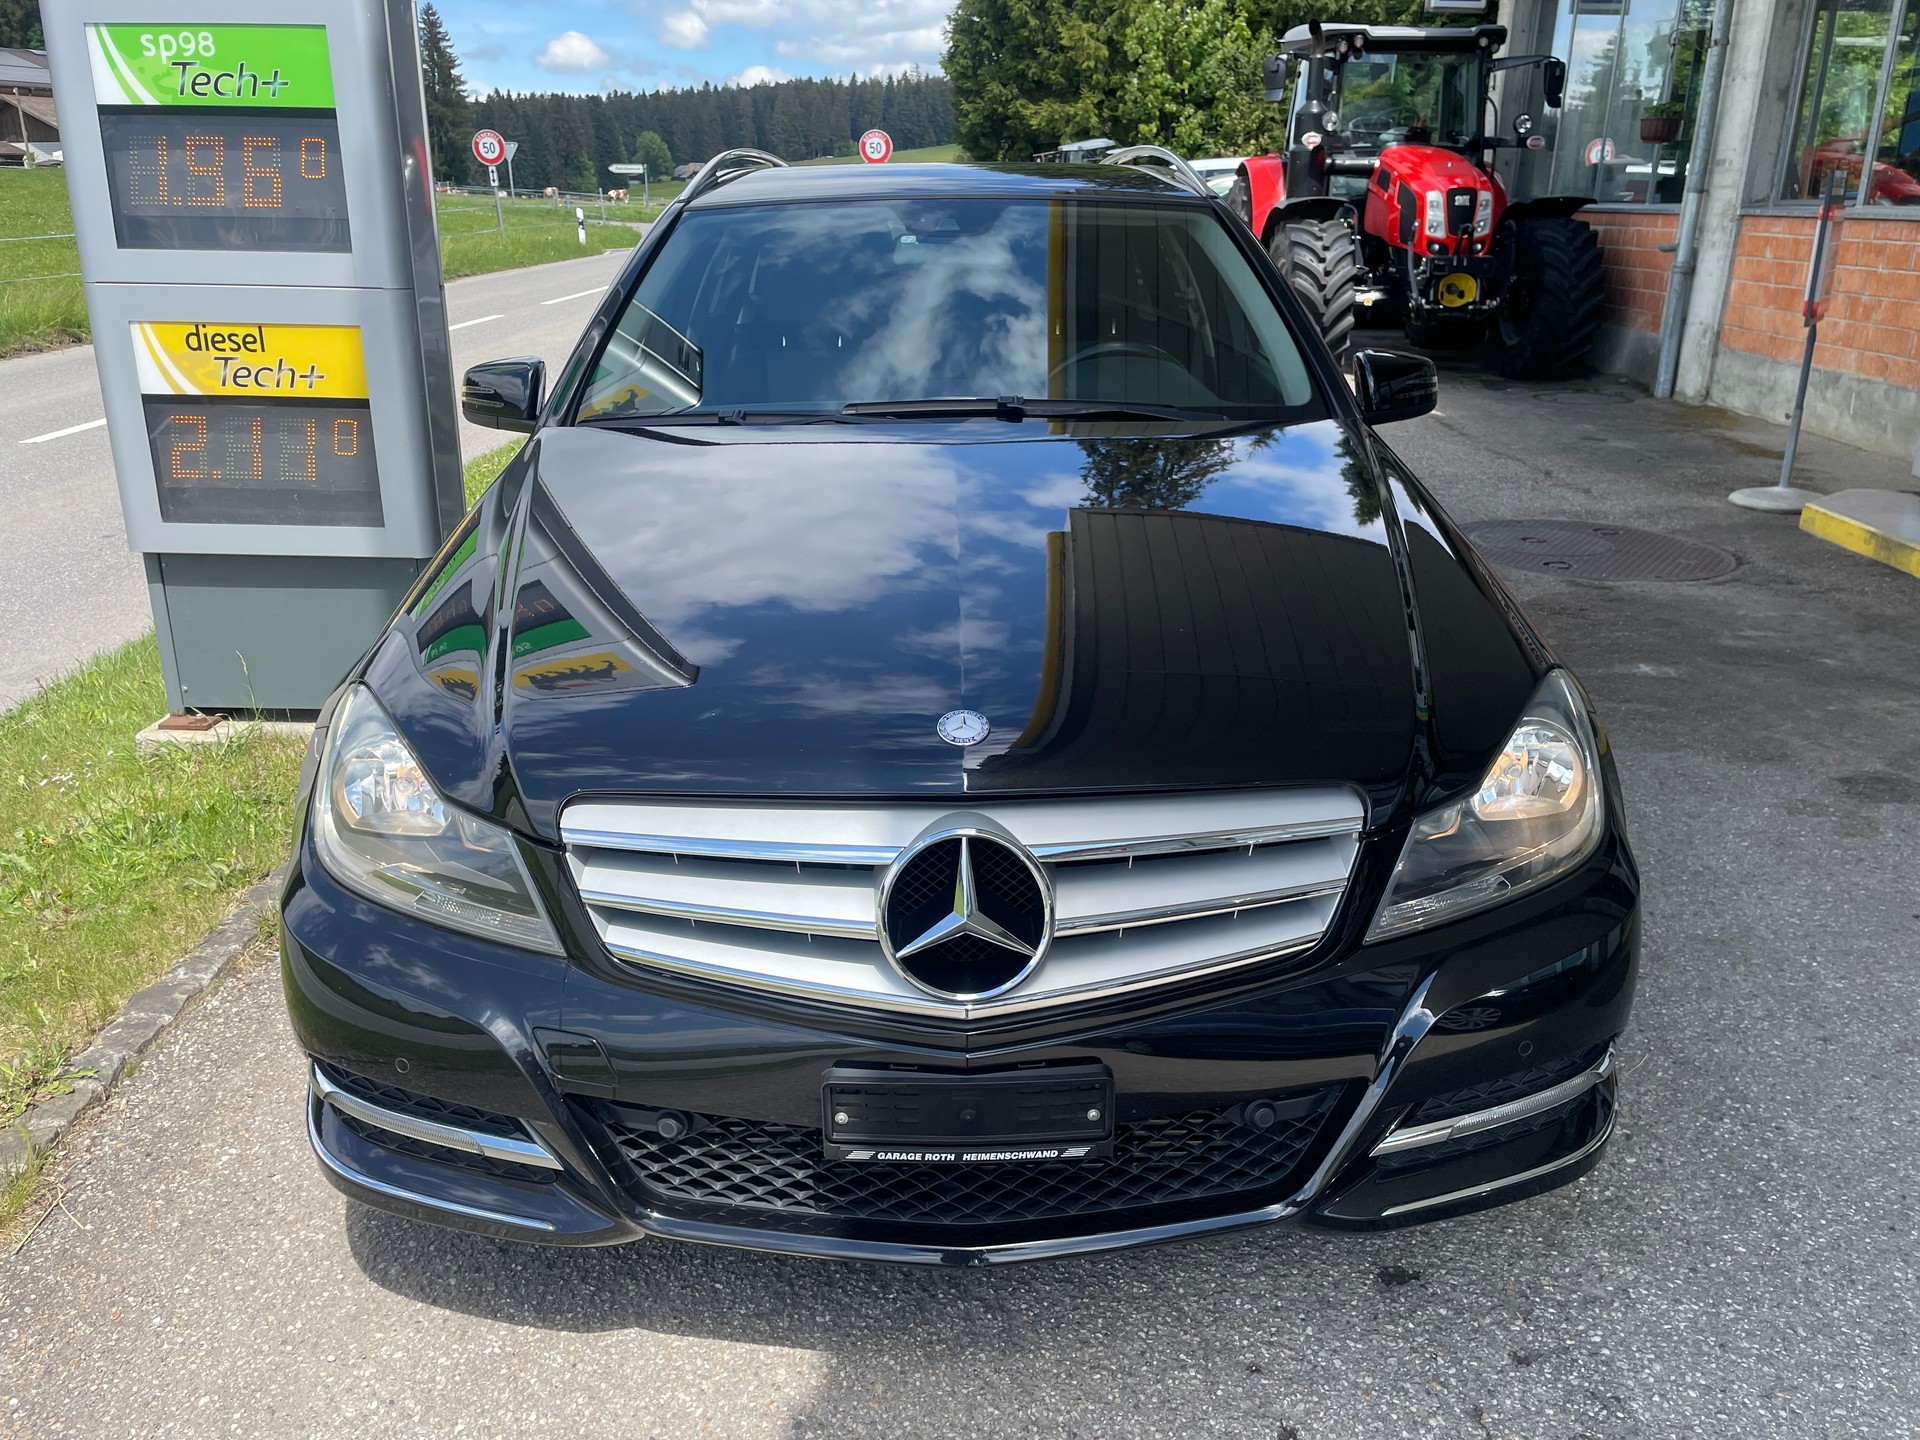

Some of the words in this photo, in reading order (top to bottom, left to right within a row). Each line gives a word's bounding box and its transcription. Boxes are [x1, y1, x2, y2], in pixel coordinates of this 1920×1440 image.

[140, 31, 216, 64] sp98
[170, 60, 290, 99] Tech+
[482, 141, 496, 154] 50
[869, 142, 882, 154] 50
[184, 323, 266, 353] diesel
[213, 356, 325, 390] Tech+
[877, 1152, 922, 1161] GARAGE
[925, 1152, 955, 1161] ROTH
[962, 1150, 1059, 1161] HEIMENSCHWAND
